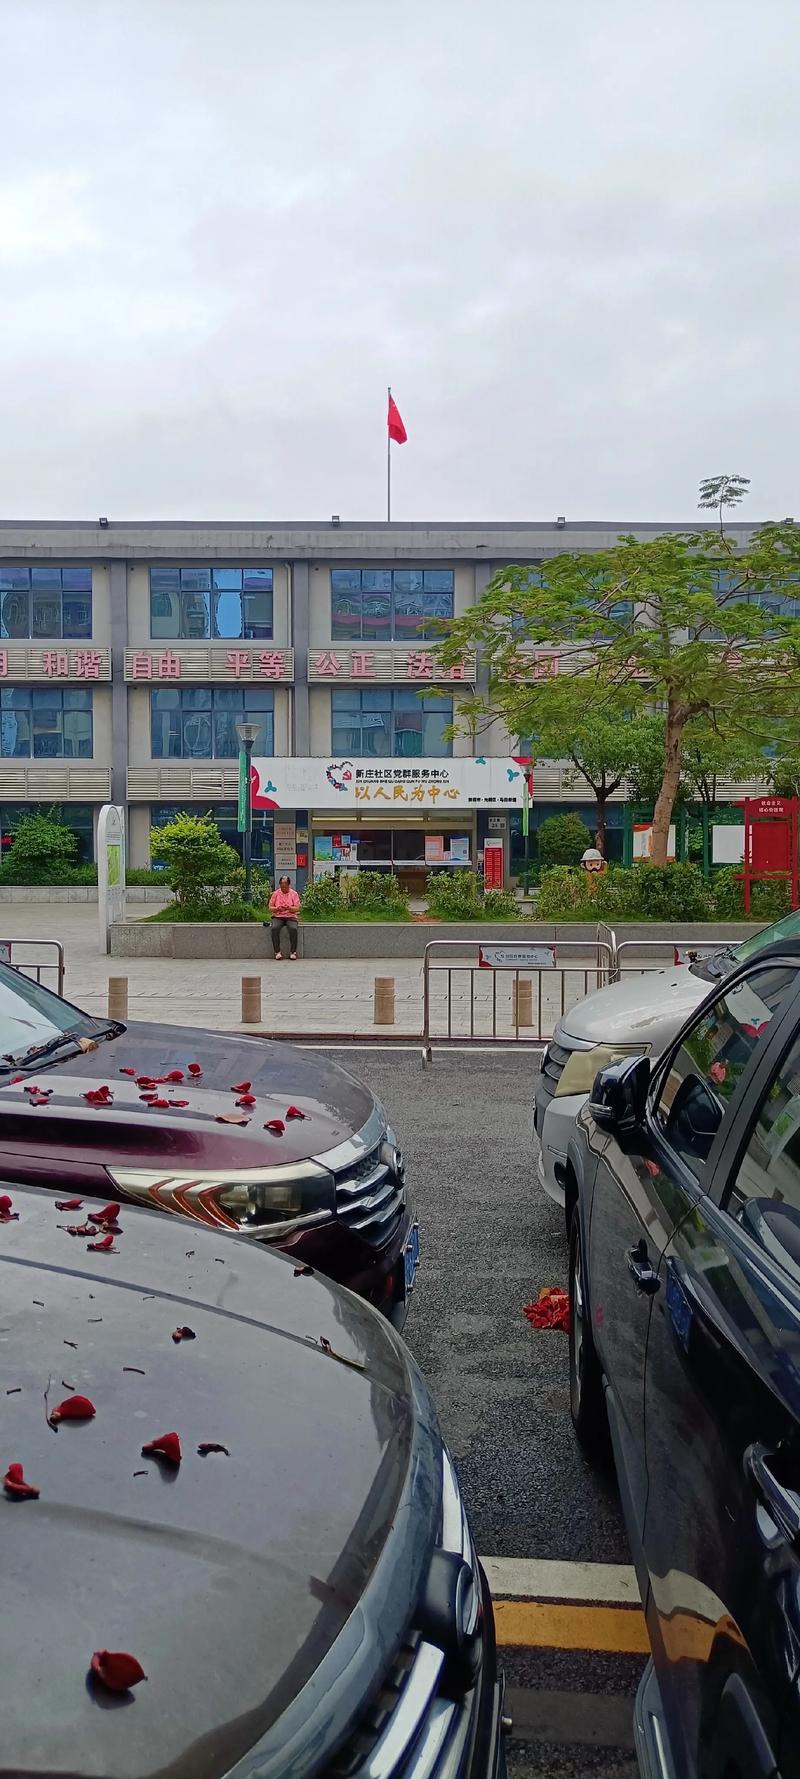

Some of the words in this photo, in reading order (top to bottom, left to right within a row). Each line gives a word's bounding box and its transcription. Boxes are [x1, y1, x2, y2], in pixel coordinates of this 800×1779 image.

[43, 650, 101, 679] 和谐
[132, 648, 181, 679] 自由
[225, 650, 286, 679] 平等
[315, 651, 377, 678] 公正
[355, 769, 449, 779] 新庄社区党群服务中心
[354, 784, 460, 804] 以人民为中心
